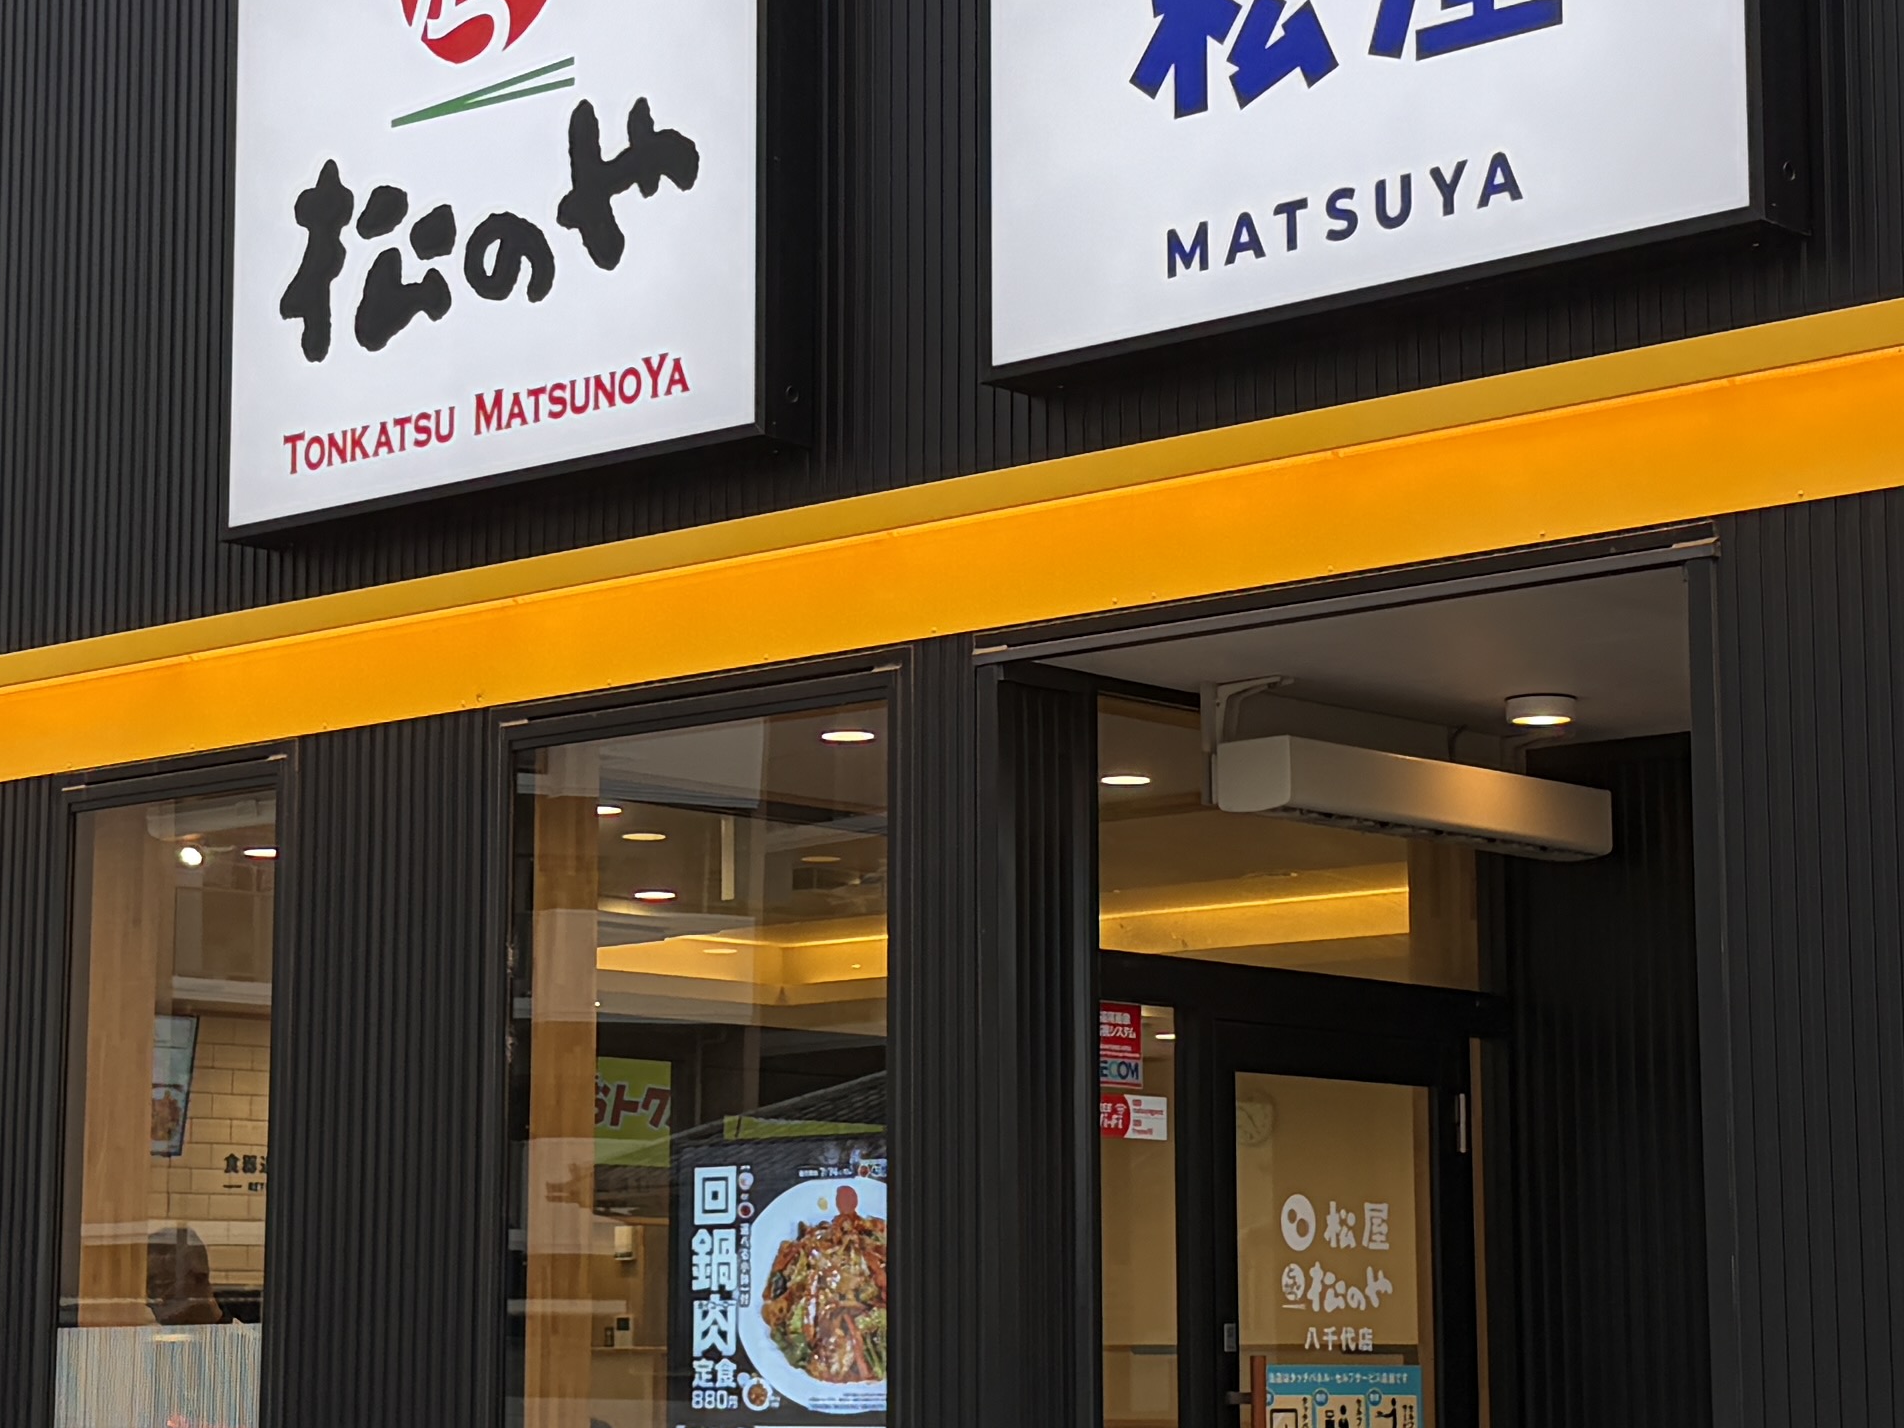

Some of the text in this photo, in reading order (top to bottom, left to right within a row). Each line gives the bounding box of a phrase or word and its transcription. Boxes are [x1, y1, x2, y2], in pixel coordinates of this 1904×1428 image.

[280, 95, 700, 363] 松のや
[1166, 151, 1524, 280] MATSUYA
[1323, 1201, 1390, 1251] 松屋
[691, 1165, 738, 1357] 回鍋肉
[1307, 1261, 1393, 1313] 松のや
[1304, 1326, 1374, 1352] 八千代店
[692, 1358, 737, 1388] 定食
[692, 1390, 738, 1410] 880円
